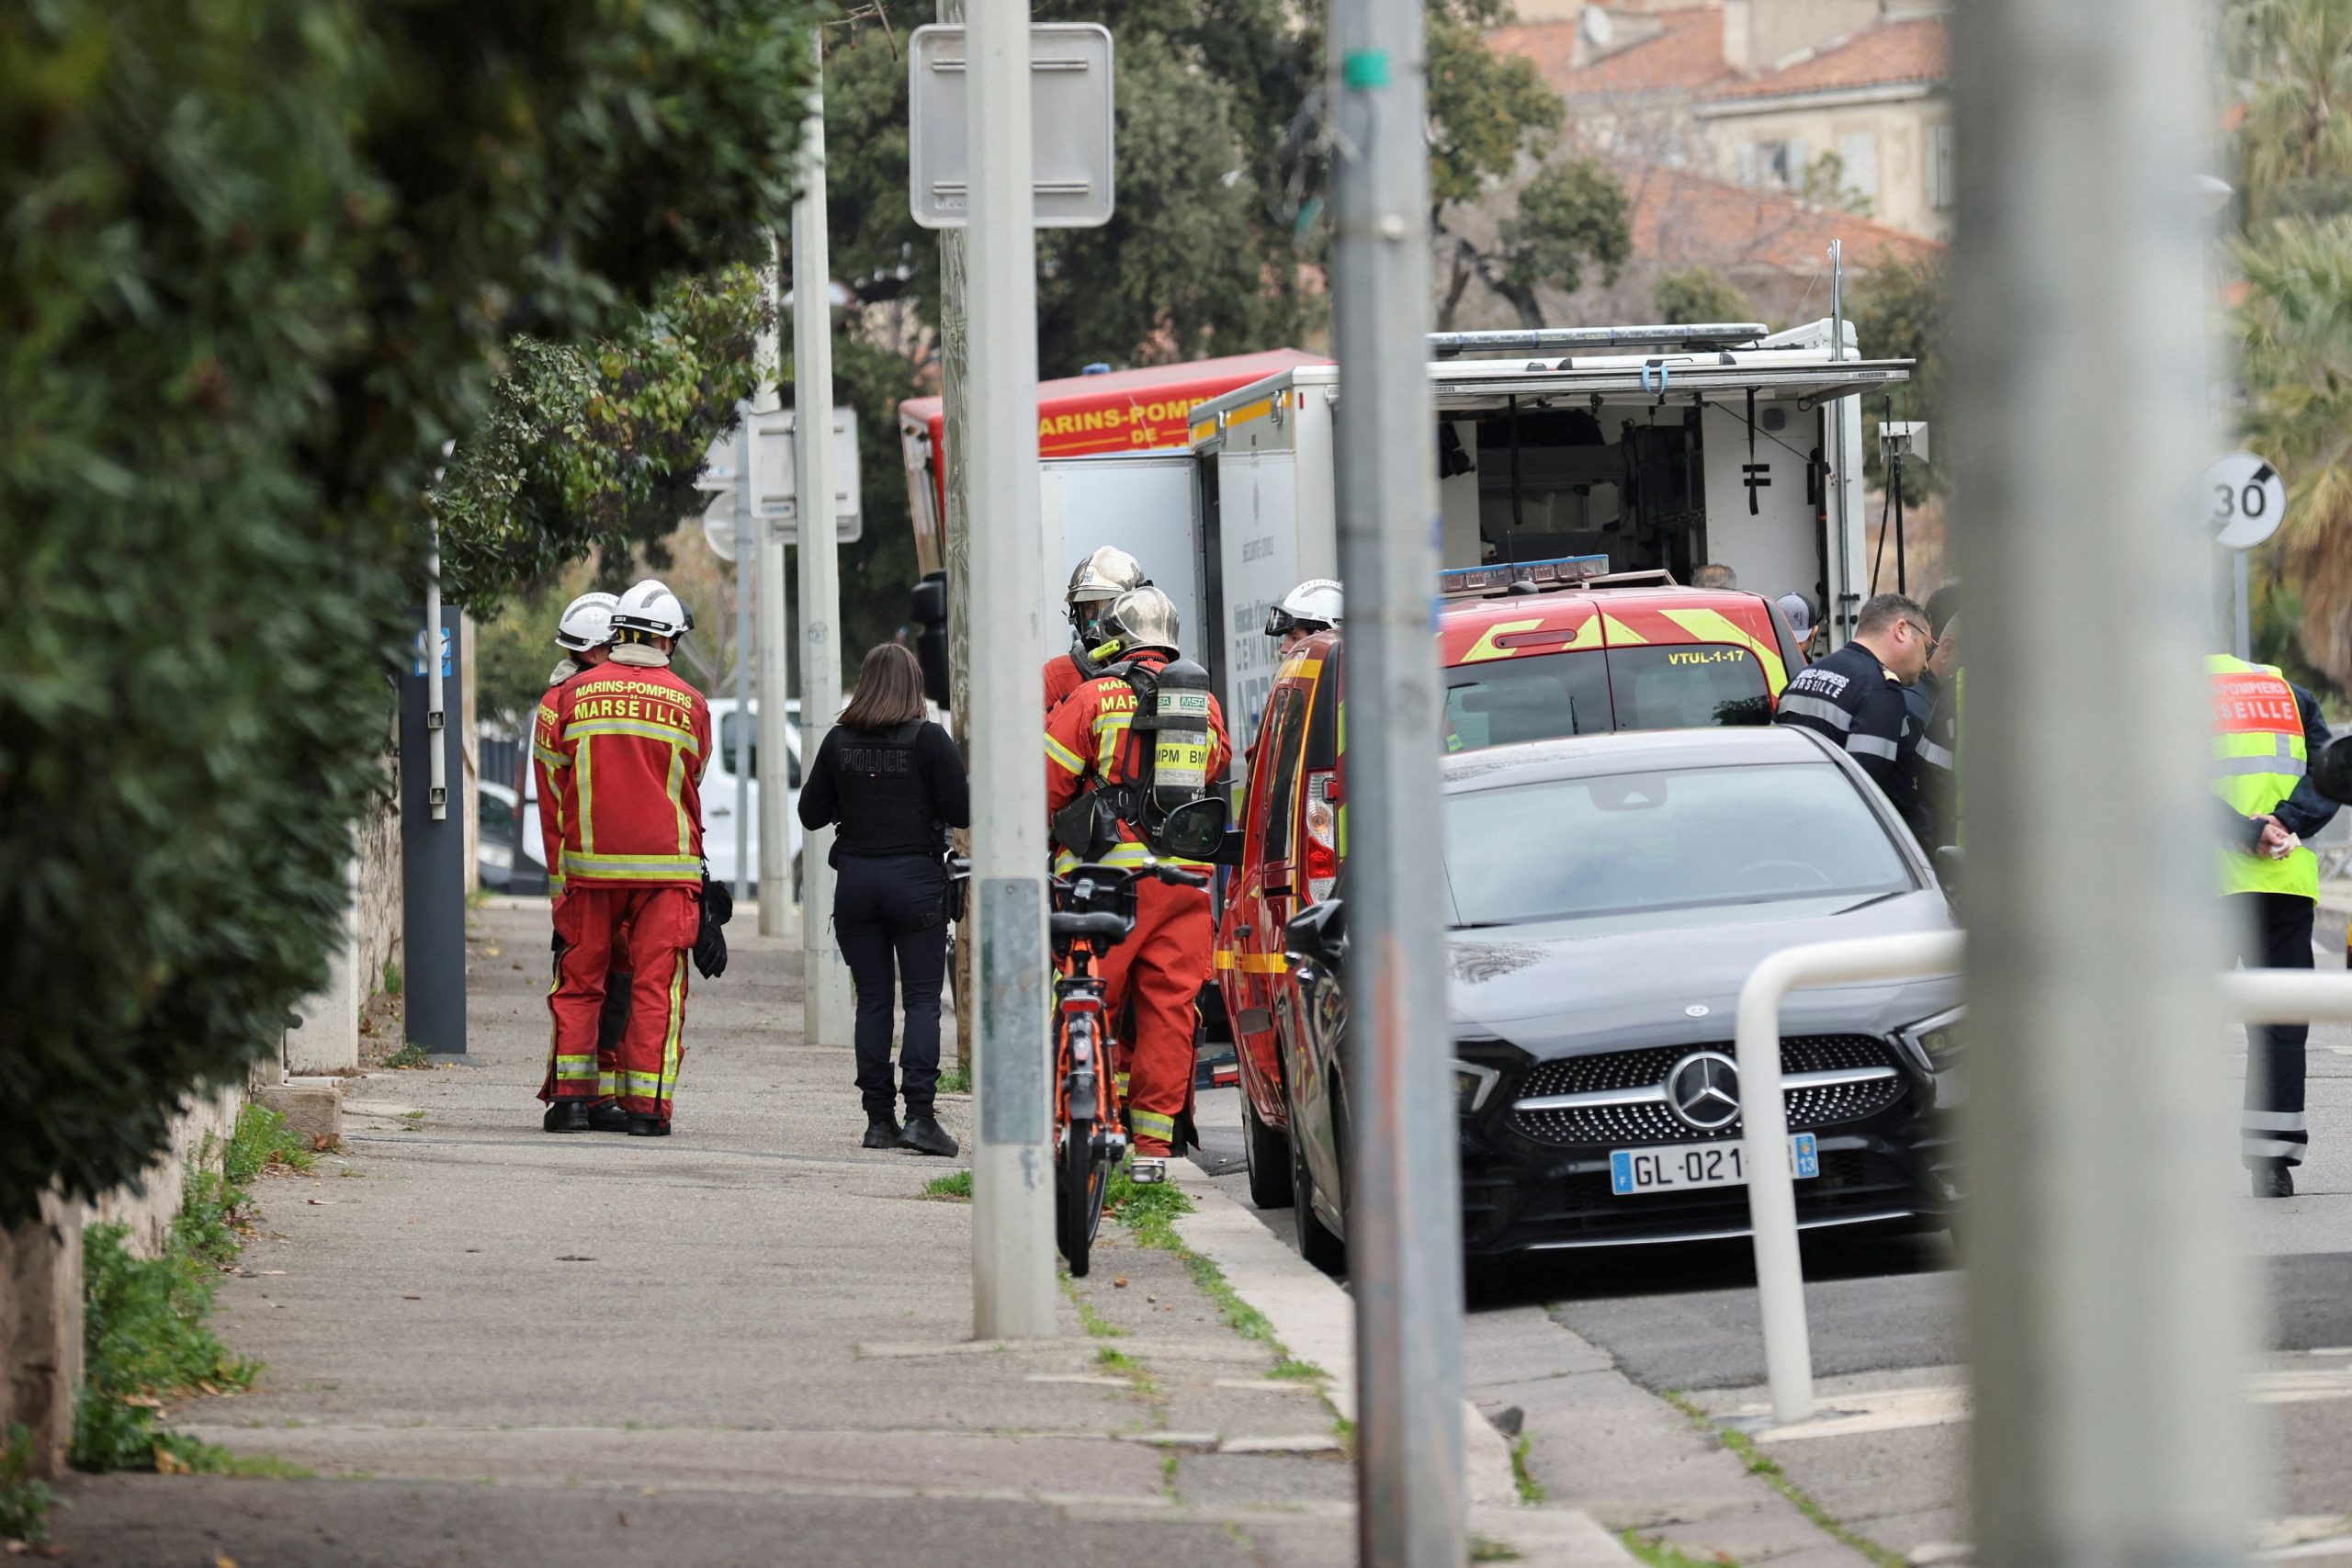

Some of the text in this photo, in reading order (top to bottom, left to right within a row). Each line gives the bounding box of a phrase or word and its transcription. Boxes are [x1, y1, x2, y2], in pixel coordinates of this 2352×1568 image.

[1131, 427, 1158, 444] DE
[2213, 483, 2266, 518] 30
[1235, 634, 1283, 671] DEMINA
[1668, 650, 1745, 665] VTUL-1-17
[575, 681, 692, 709] MARINS-POMPIERS
[1098, 680, 1132, 692] MAR
[1181, 697, 1204, 707] MSA
[574, 699, 692, 731] MARSEILLE
[840, 748, 908, 773] POLICE
[1634, 1148, 1743, 1186] GL-021
[1800, 1156, 1815, 1174] 13
[1620, 1176, 1626, 1187] F
